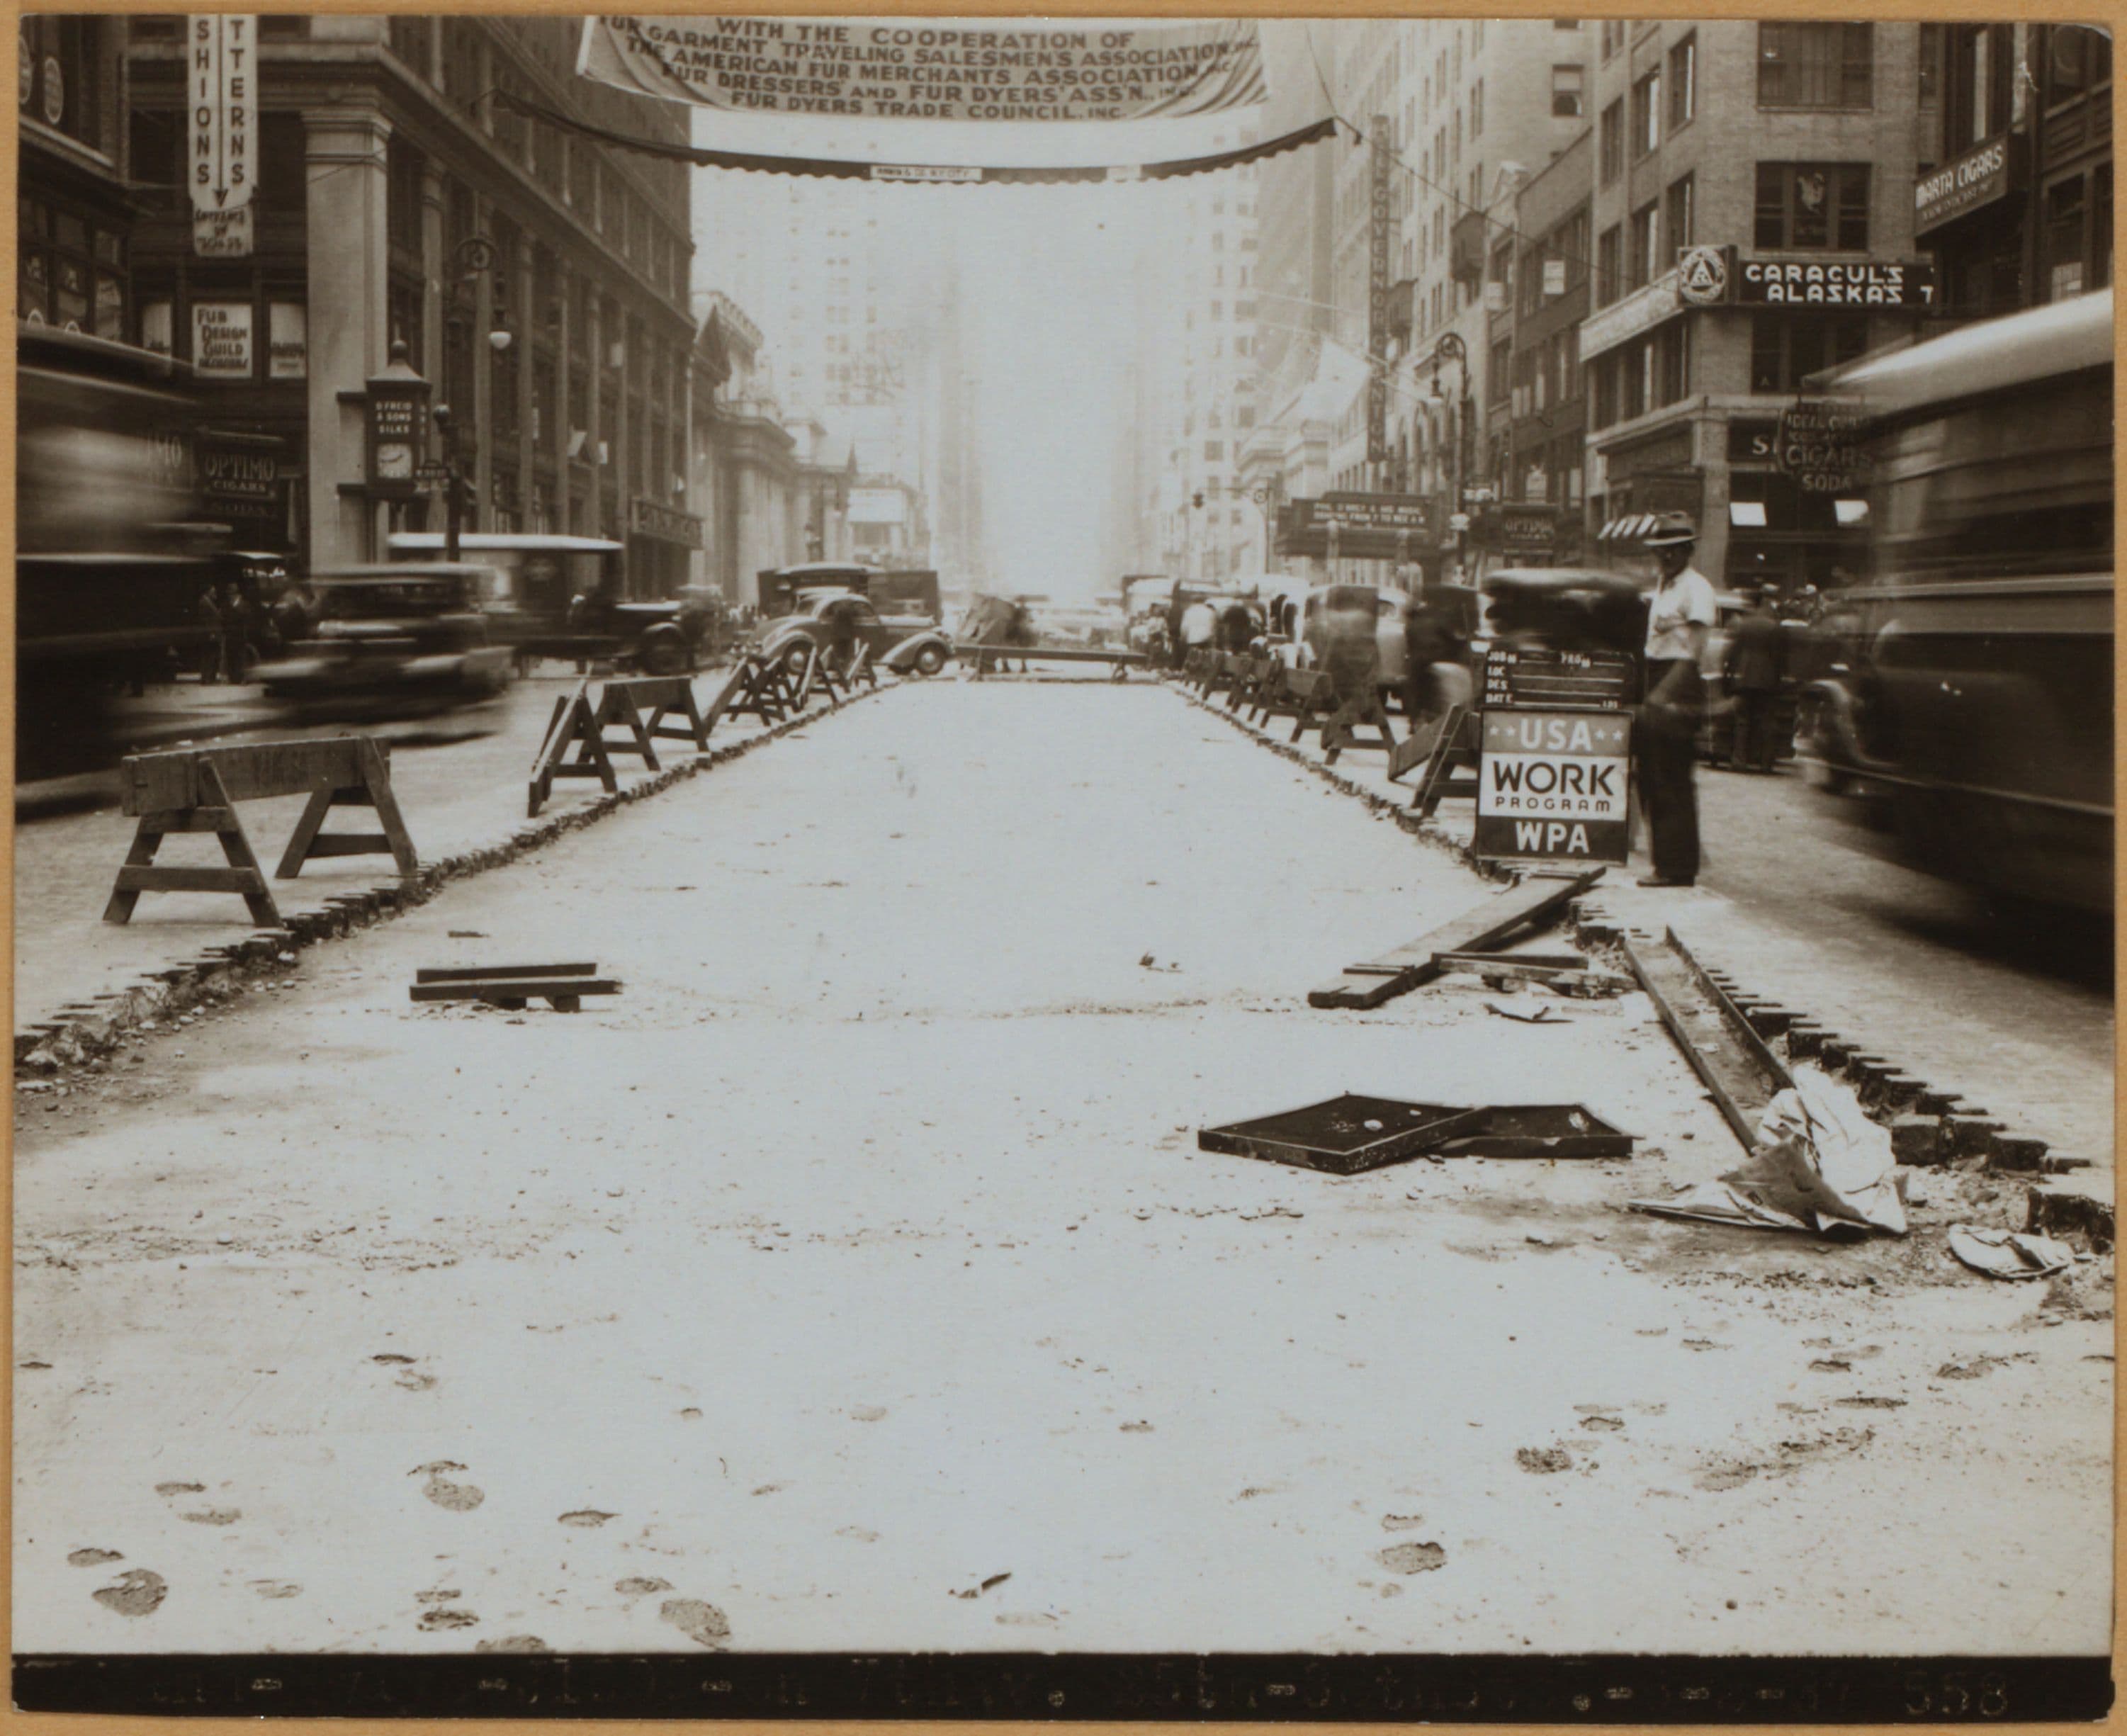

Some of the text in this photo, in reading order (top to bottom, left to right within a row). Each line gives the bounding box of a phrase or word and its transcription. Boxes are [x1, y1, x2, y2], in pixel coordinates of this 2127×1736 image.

[648, 26, 767, 54] GARMENT
[782, 43, 905, 63] TRAVELING
[716, 17, 1134, 49] WITH THE COOPERATION OF
[672, 48, 798, 75] AMERICAN
[809, 63, 849, 79] FUR
[859, 65, 1010, 84] MERCHANTS
[730, 92, 777, 110] FUR
[787, 96, 863, 114] DYERS
[874, 101, 953, 118] TRADE
[850, 86, 897, 99] AND
[910, 85, 962, 101] FUR
[1958, 145, 2003, 188] CIGARS
[1745, 264, 1904, 283] CARACUL'S
[1767, 283, 1903, 303] ALASKA'S
[198, 308, 227, 325] FUR
[204, 454, 276, 482] OPTIMO
[213, 480, 267, 493] CIGARS
[1488, 650, 1506, 663] JOB
[1485, 693, 1513, 703] DATE
[1521, 718, 1593, 752] USA
[1494, 761, 1616, 796] WORK
[1495, 796, 1610, 812] PROGRAM
[1515, 821, 1590, 854] WPA
